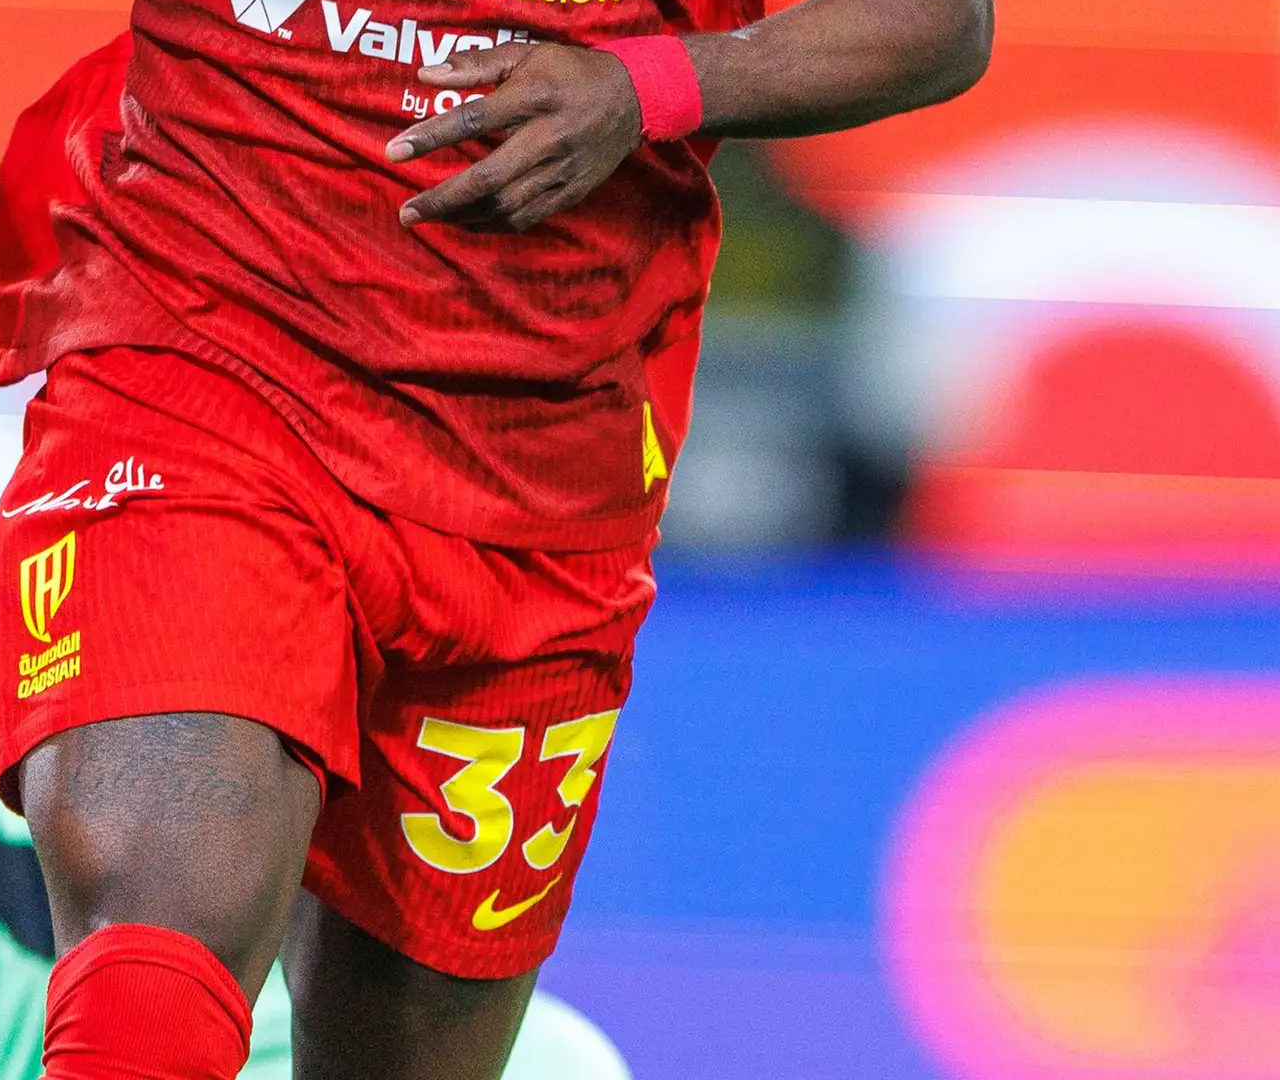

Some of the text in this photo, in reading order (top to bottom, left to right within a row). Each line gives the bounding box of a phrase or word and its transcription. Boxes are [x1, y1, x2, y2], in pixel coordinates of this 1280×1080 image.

[401, 88, 429, 120] by
[17, 655, 81, 699] QADSIAH
[400, 708, 622, 874] 33
